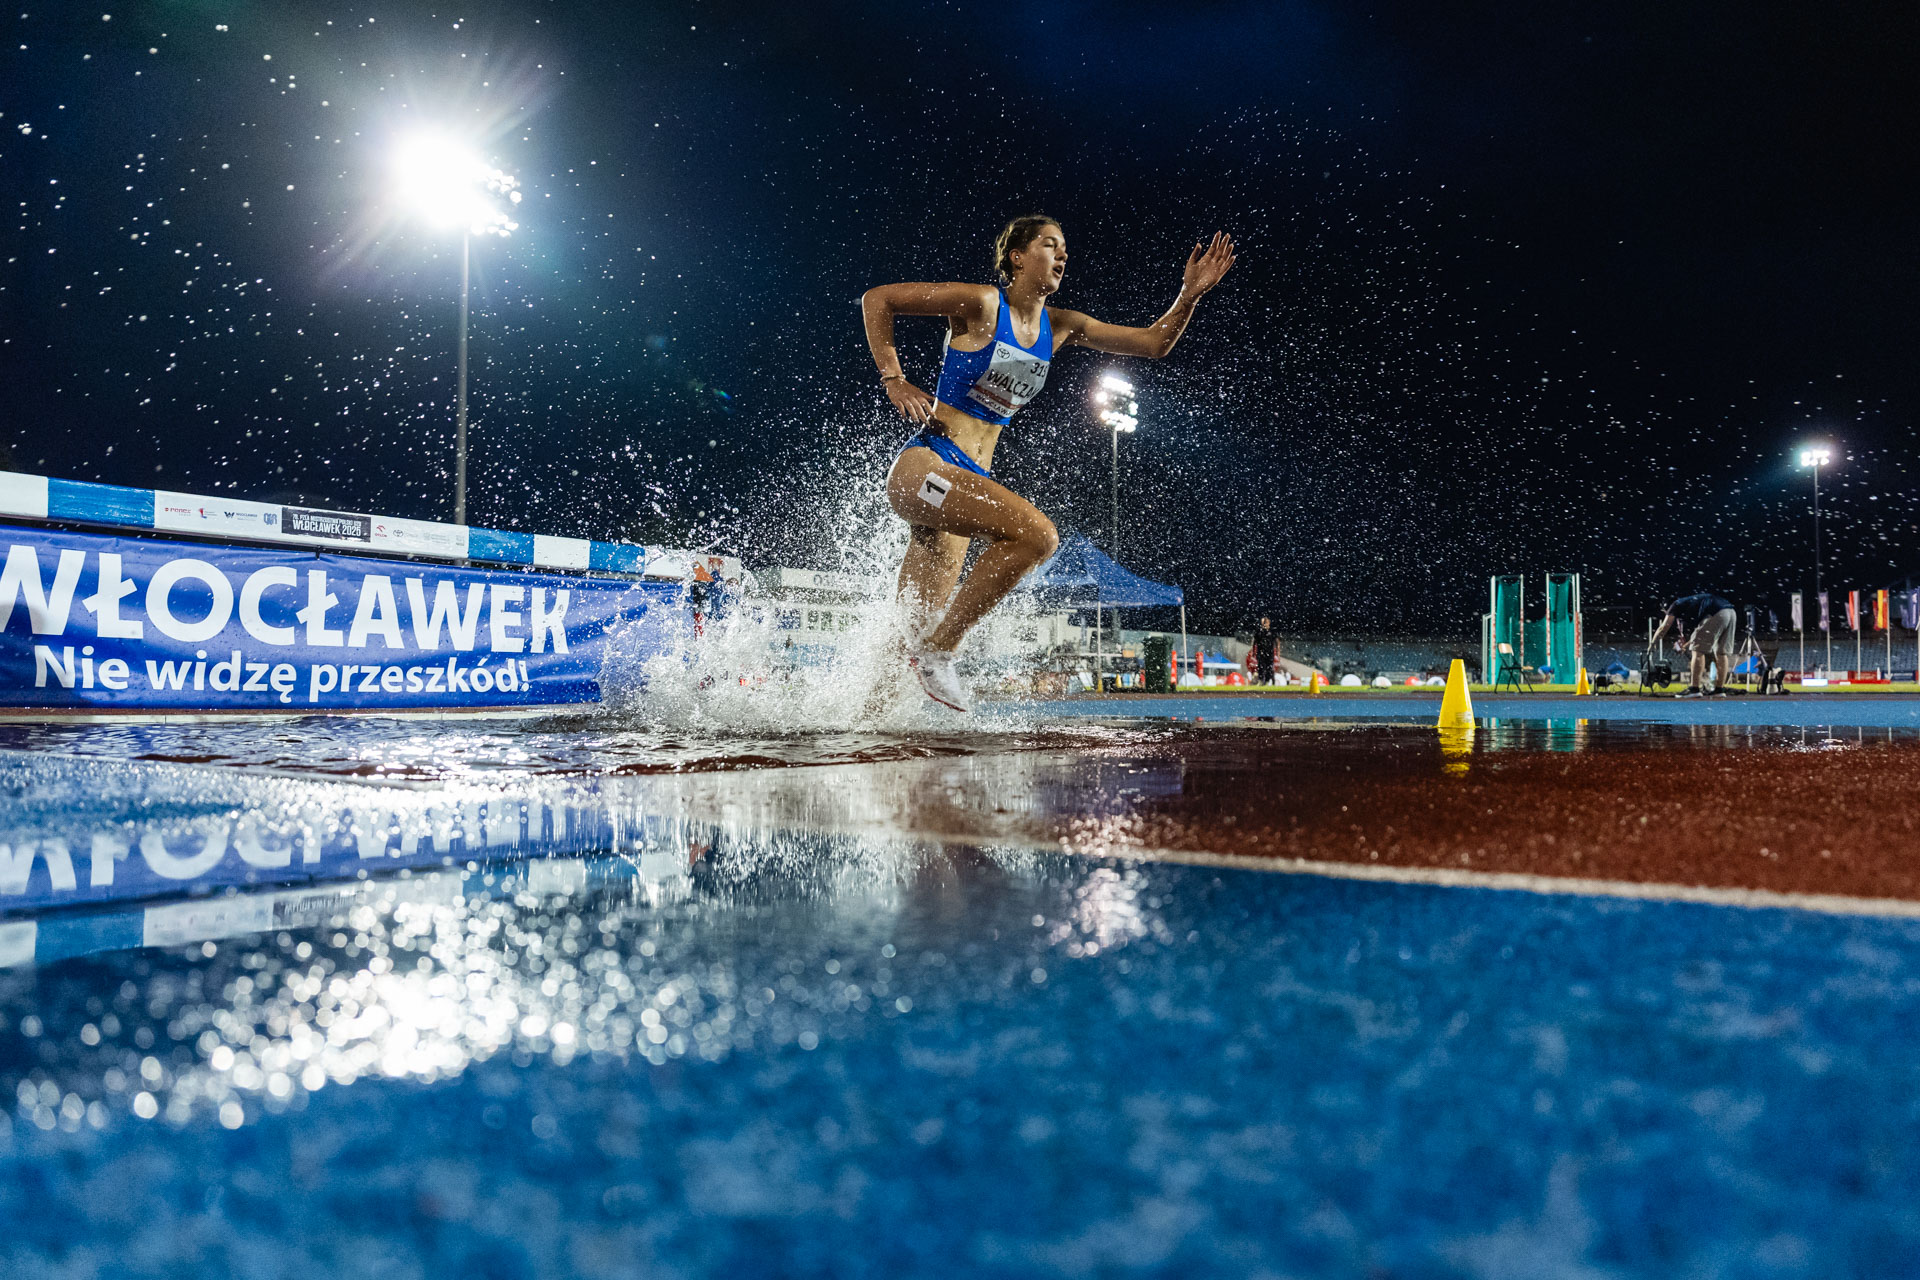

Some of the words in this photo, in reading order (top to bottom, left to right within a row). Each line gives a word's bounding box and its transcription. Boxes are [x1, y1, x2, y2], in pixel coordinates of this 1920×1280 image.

[976, 394, 1014, 416] WŁOCŁAW
[926, 480, 946, 495] 1
[293, 519, 340, 534] WŁOCŁAWEK
[0, 544, 570, 654] WŁOCŁAWEK
[34, 645, 130, 688] Nie
[145, 650, 297, 703] widzę
[309, 655, 530, 702] przeszkód!
